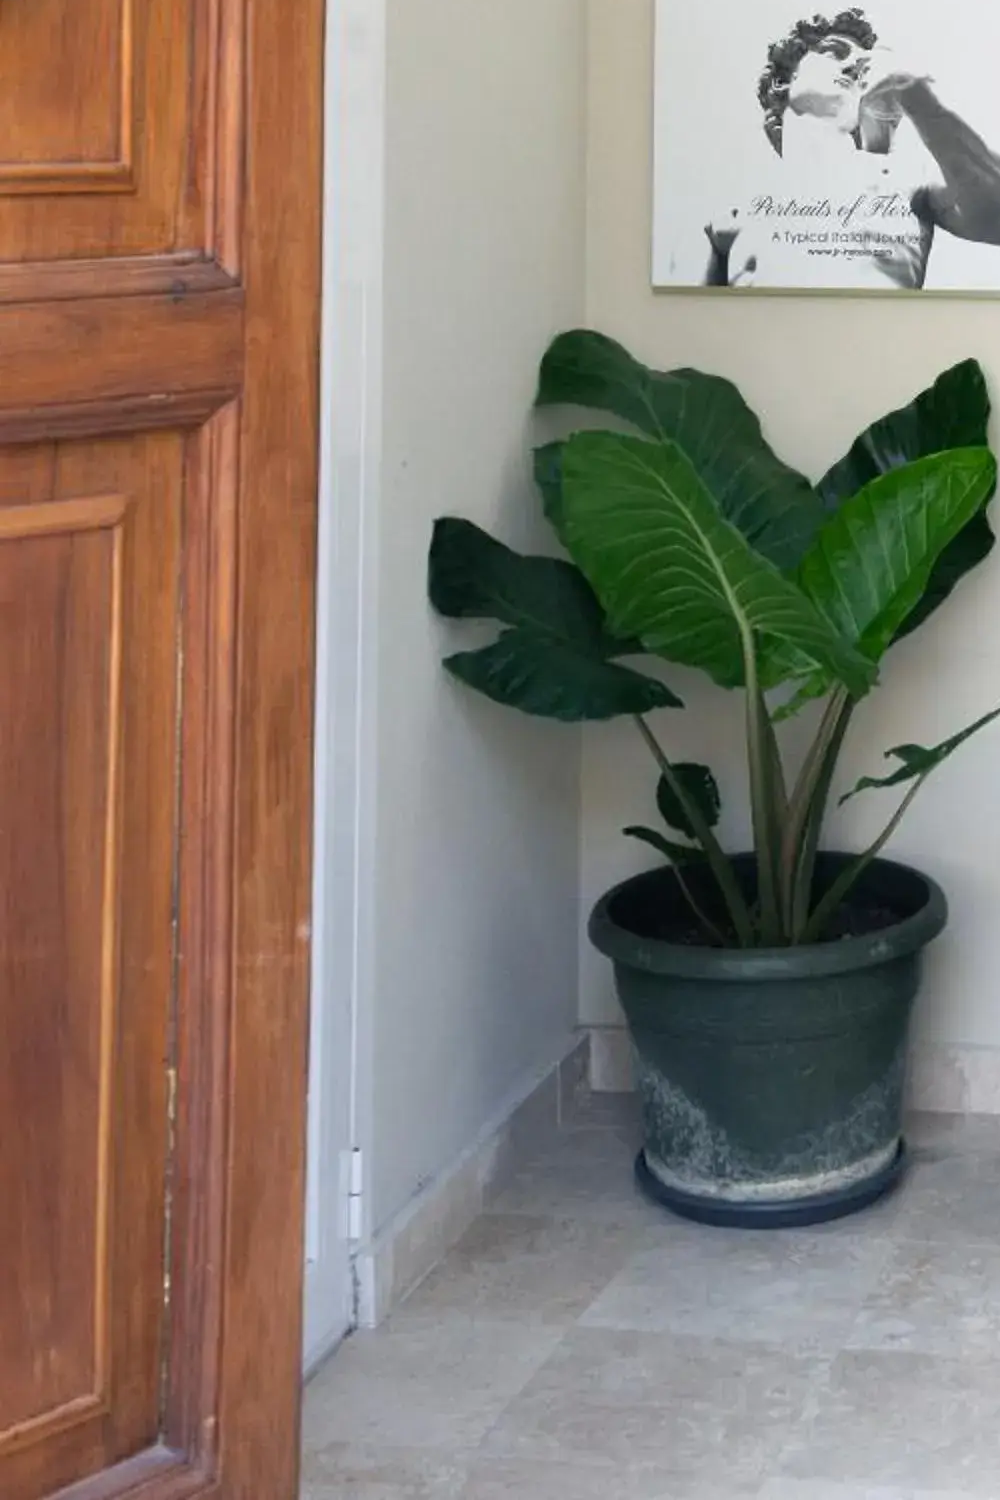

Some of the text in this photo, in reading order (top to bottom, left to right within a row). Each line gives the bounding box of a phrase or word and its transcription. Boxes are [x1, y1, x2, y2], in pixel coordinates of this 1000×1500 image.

[748, 195, 831, 217] Portraits
[837, 195, 867, 228] of
[771, 232, 781, 242] A
[784, 231, 828, 244] Typical
